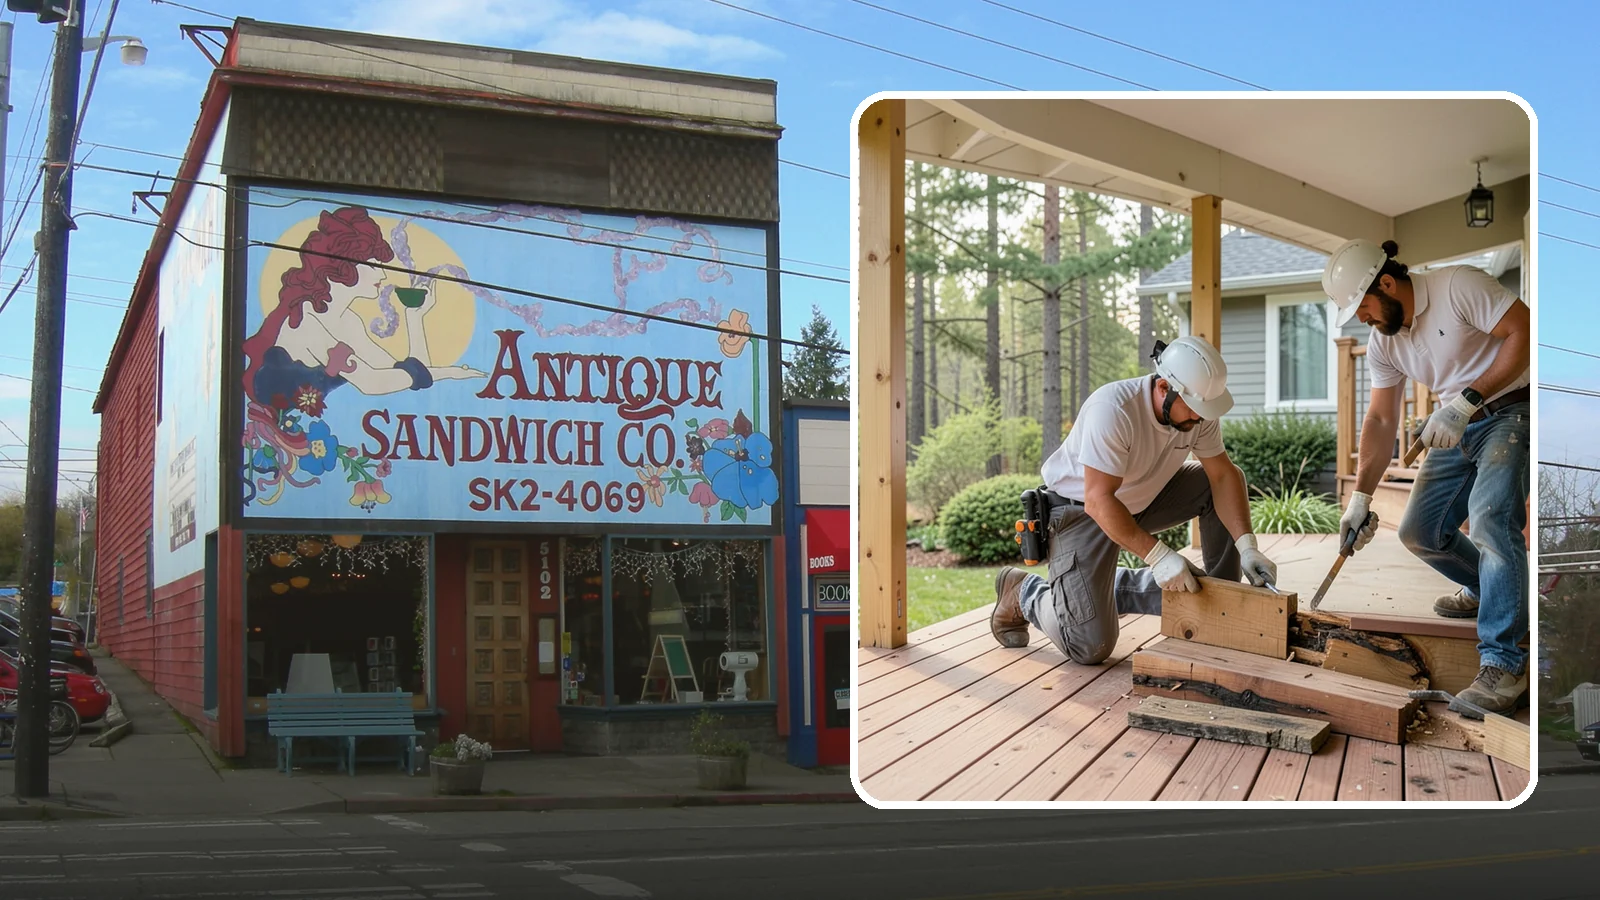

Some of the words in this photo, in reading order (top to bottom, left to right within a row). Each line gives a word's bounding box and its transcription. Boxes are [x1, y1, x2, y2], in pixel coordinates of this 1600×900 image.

[361, 408, 604, 467] SANDWICH
[617, 422, 685, 468] CO.
[469, 477, 646, 513] SK2-4069
[540, 541, 551, 599] 5102
[809, 555, 834, 569] BOOKS
